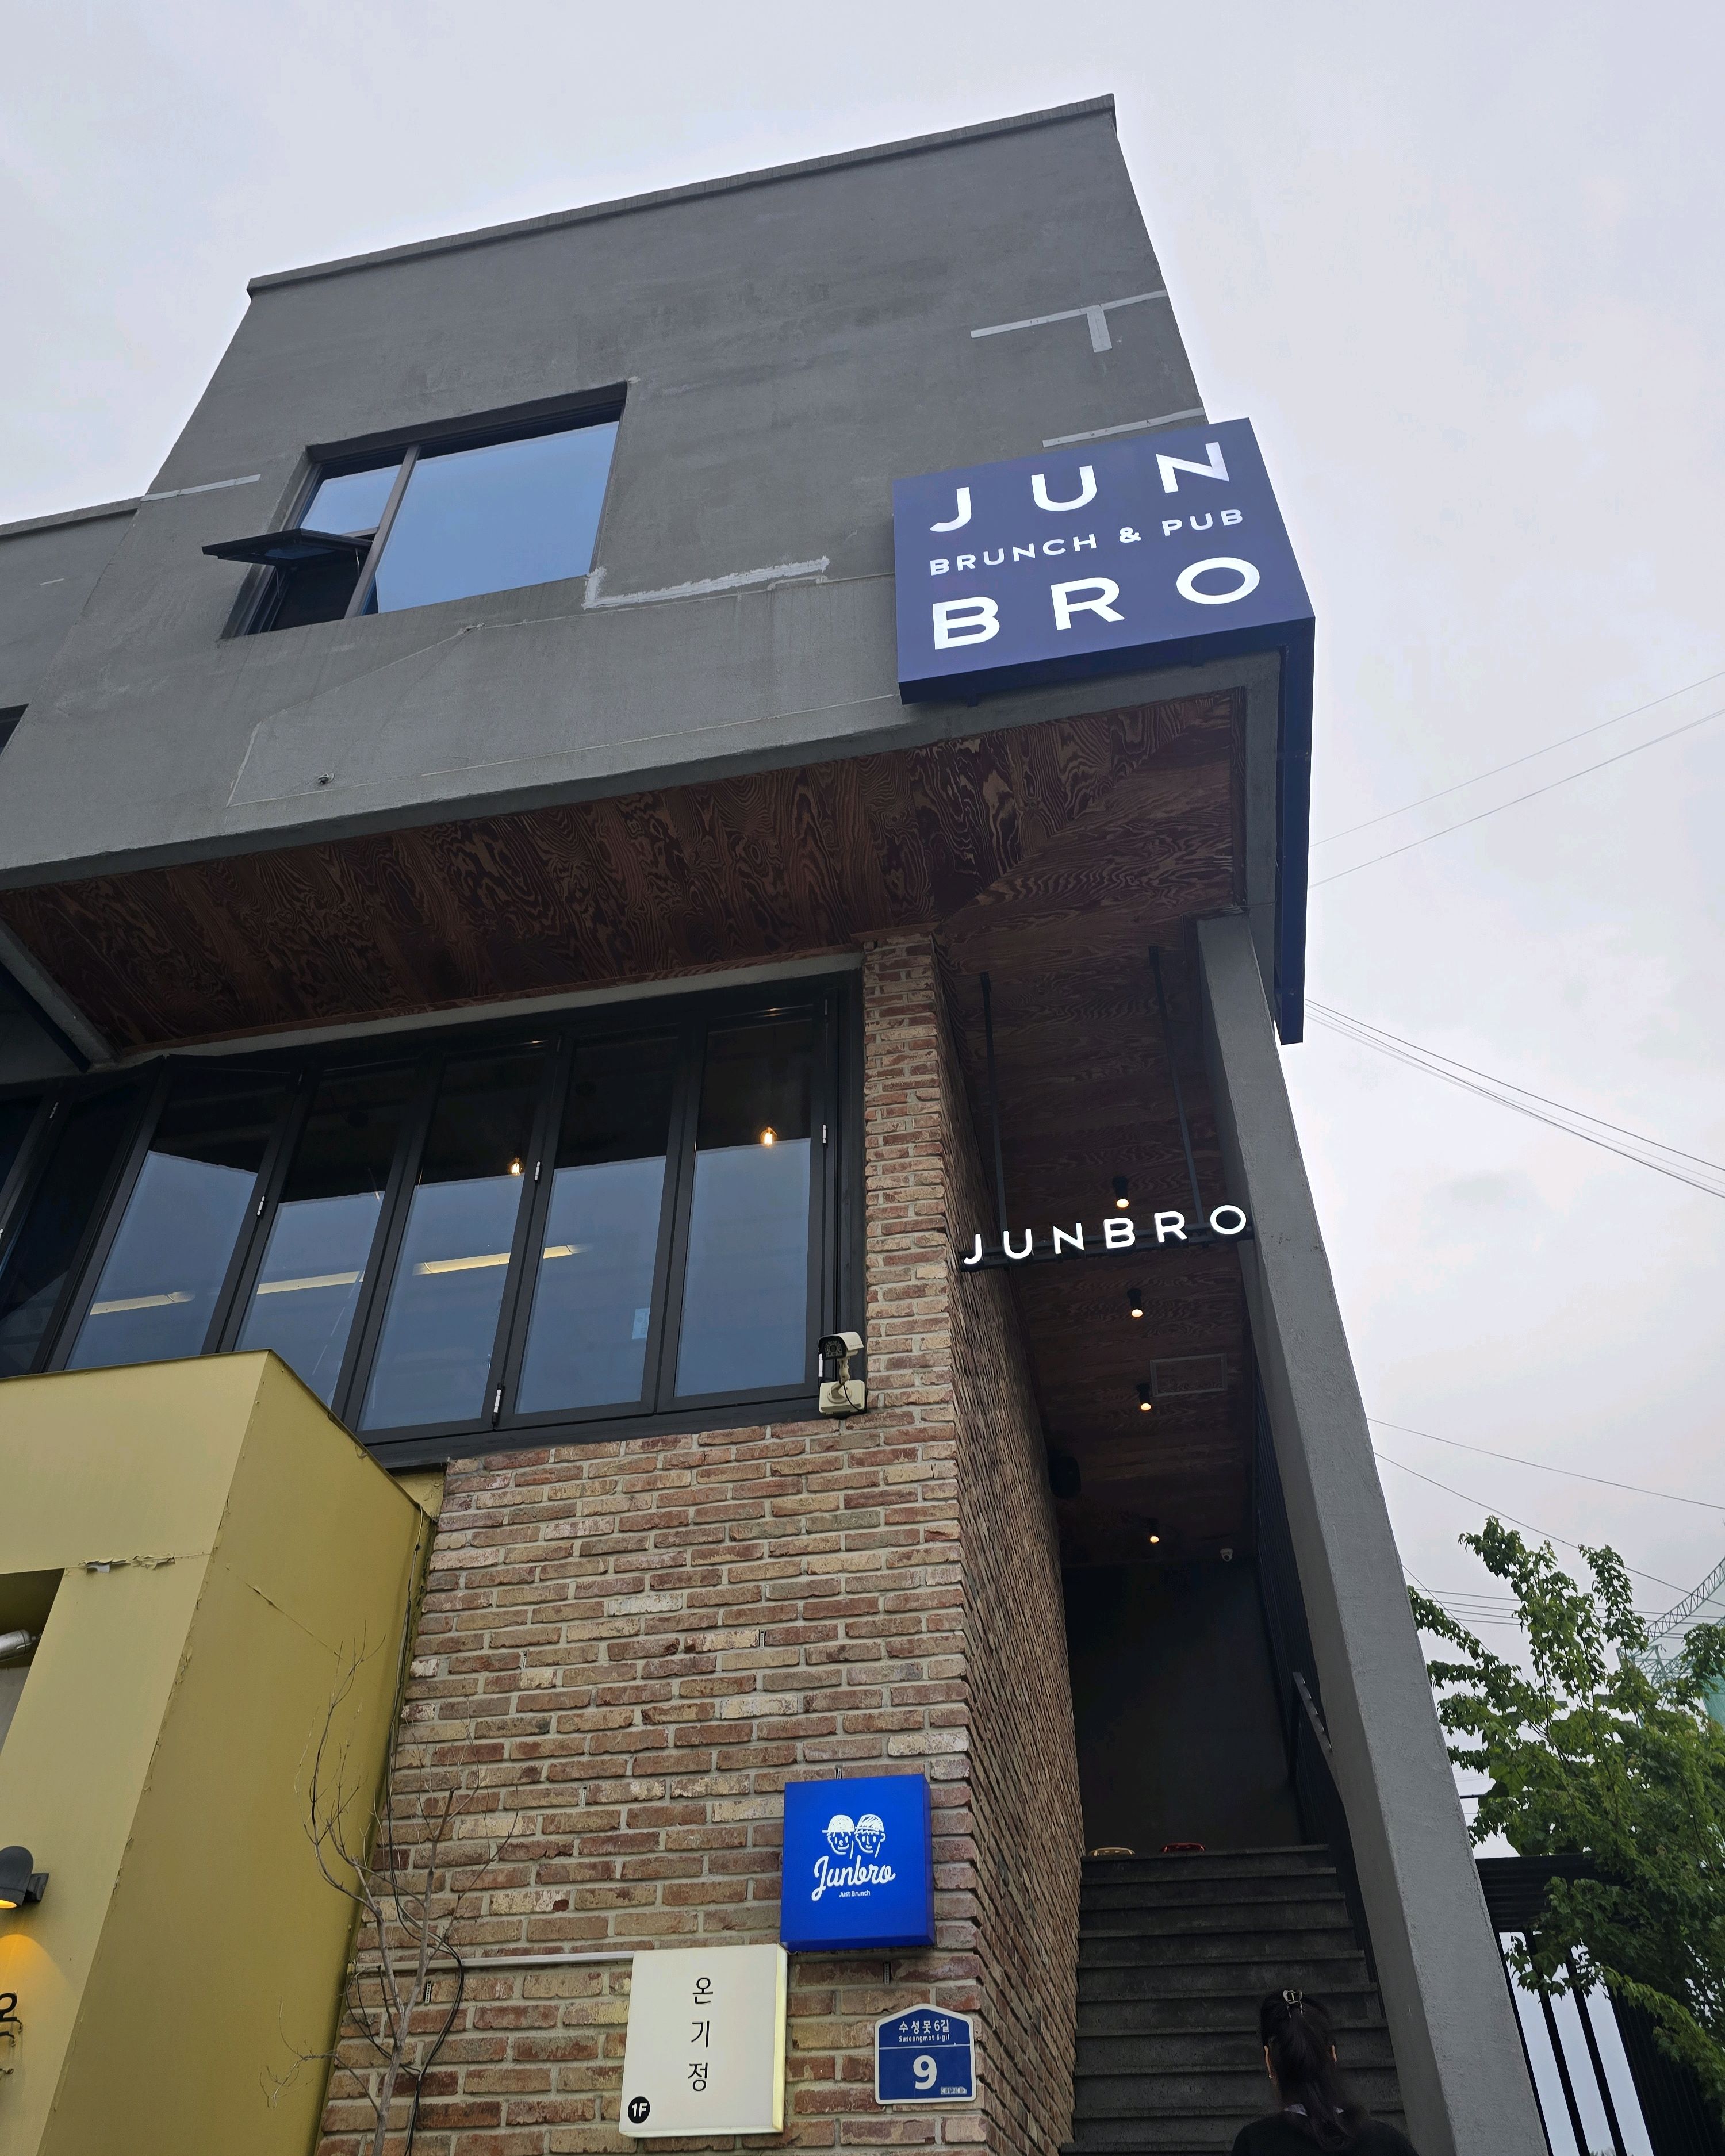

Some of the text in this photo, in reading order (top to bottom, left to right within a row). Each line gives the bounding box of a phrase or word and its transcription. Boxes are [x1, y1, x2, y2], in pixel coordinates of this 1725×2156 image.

[930, 442, 1230, 532] JUN
[930, 509, 1244, 576] BRUNCH & PUB
[932, 557, 1260, 650] BRO
[963, 1204, 1247, 1265] JUNBRO
[811, 1855, 896, 1902] Junbro
[688, 1977, 714, 2092] 온기정
[899, 2033, 949, 2043] Suseongmot 6-gil
[913, 2055, 937, 2090] 9
[631, 2102, 647, 2117] 1F
